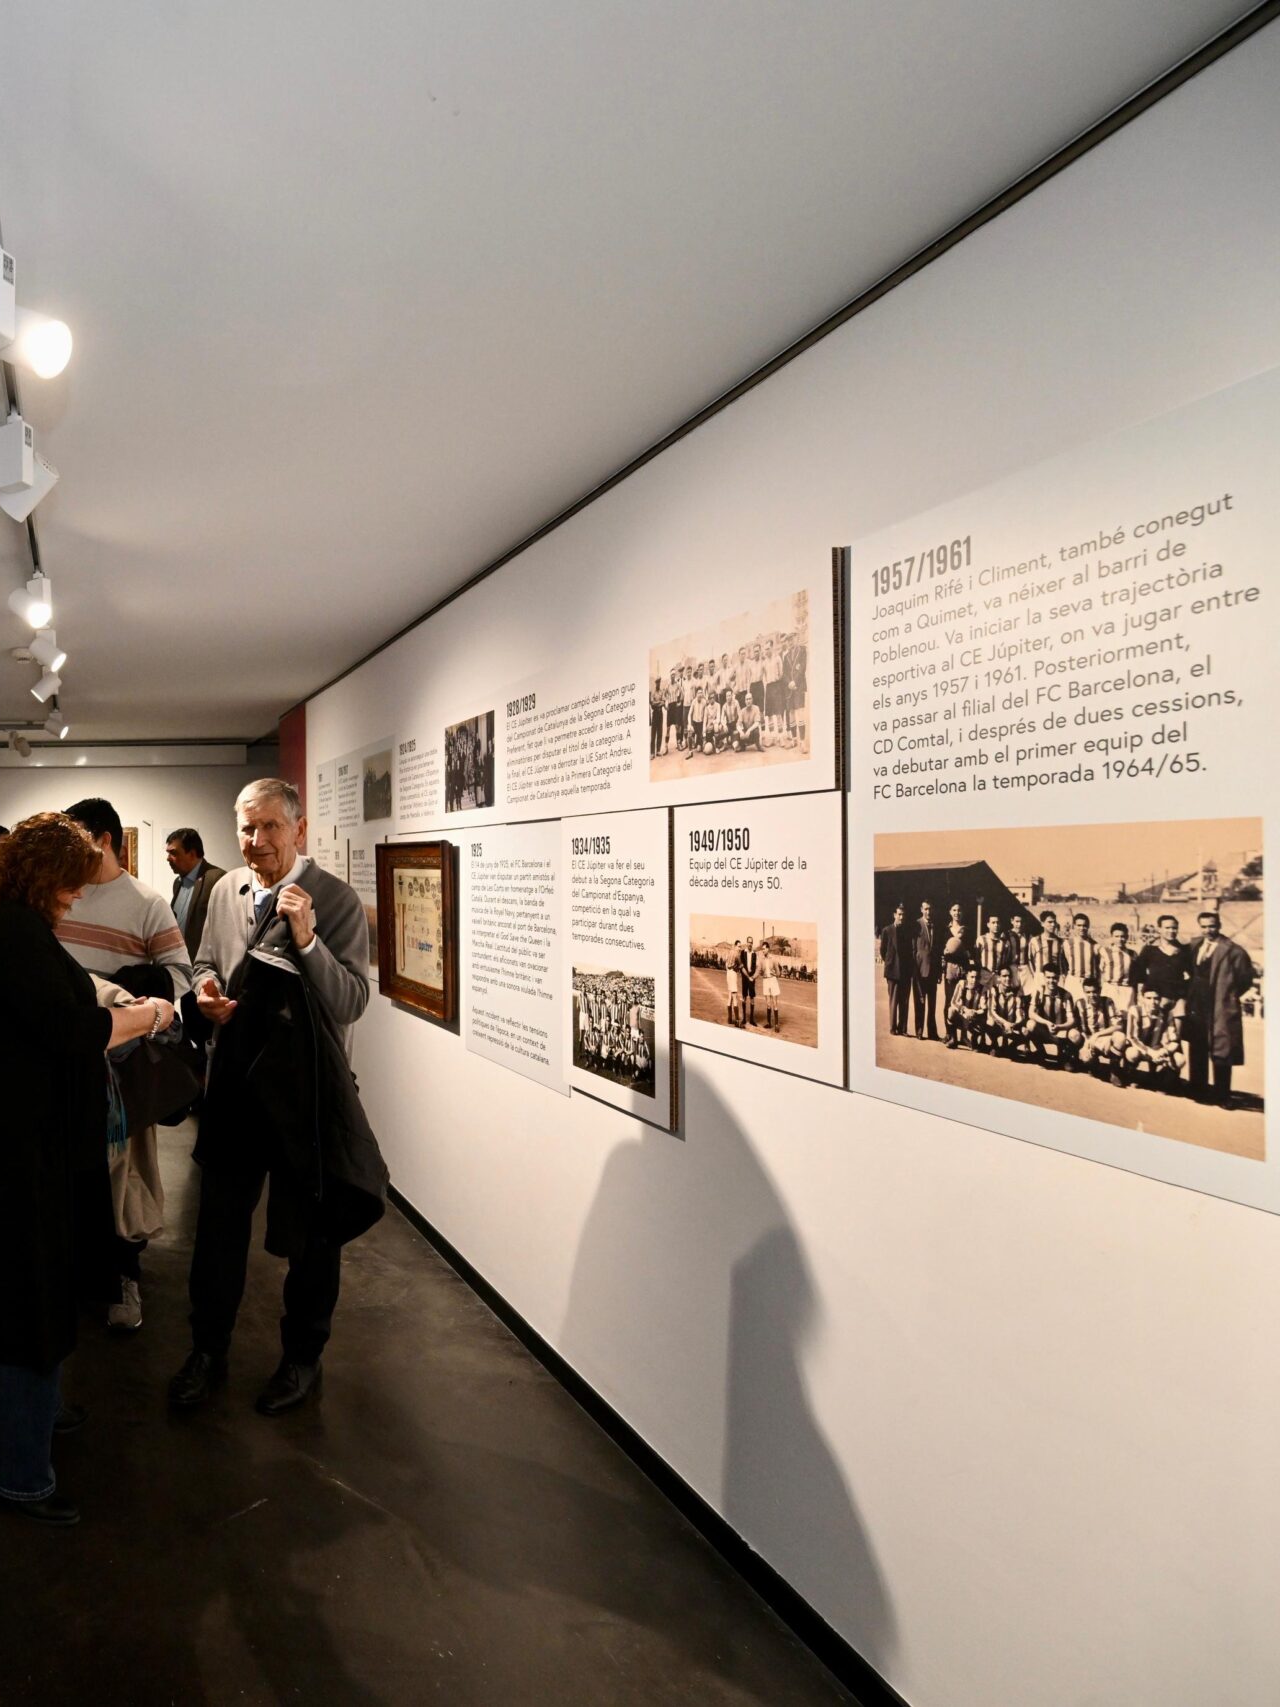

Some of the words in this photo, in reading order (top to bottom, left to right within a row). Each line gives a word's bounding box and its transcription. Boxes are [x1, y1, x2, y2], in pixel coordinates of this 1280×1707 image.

[872, 593, 929, 621] Joaquim
[934, 578, 964, 601] Rifé
[978, 553, 1052, 586] Climent,
[1059, 525, 1125, 562] també
[1133, 493, 1233, 538] conegut
[872, 536, 972, 598] 1957/1961
[872, 626, 900, 643] com
[904, 623, 912, 634] a
[917, 602, 978, 630] Quimet,
[983, 596, 1002, 610] va
[1009, 577, 1066, 604] néixer
[1072, 564, 1089, 586] al
[1098, 548, 1147, 579] barri
[1156, 539, 1187, 562] de
[873, 639, 940, 665] Poblenou.
[944, 629, 964, 646] Va
[969, 616, 1021, 641] iniciar
[1027, 608, 1042, 626] la
[1049, 598, 1093, 620] seva
[1100, 562, 1223, 606] trajectòria
[872, 664, 936, 689] esportiva
[941, 653, 954, 672] al
[960, 647, 983, 667] CE
[987, 636, 1053, 662] Júpiter,
[1060, 629, 1084, 645] on
[1091, 621, 1115, 636] va
[1122, 605, 1182, 637] jugar
[1191, 587, 1260, 615] entre
[872, 693, 892, 710] els
[896, 689, 928, 707] anys
[933, 676, 969, 698] 1957
[984, 665, 1027, 687] 1961.
[1034, 633, 1190, 678] Posteriorment,
[506, 693, 536, 718] 1928/1929
[873, 721, 888, 732] va
[892, 711, 939, 734] passar
[943, 702, 956, 721] al
[962, 695, 995, 717] filial
[1002, 689, 1029, 710] del
[1036, 684, 1062, 705] FC
[1068, 669, 1181, 699] Barcelona,
[1190, 654, 1211, 678] el
[873, 738, 894, 755] CD
[897, 728, 953, 752] Comtal,
[968, 717, 1036, 742] després
[1043, 711, 1067, 731] de
[1074, 706, 1124, 726] dues
[1132, 690, 1243, 718] cessions,
[873, 766, 888, 777] va
[892, 757, 949, 776] debutar
[954, 748, 989, 768] amb
[994, 745, 1009, 764] el
[1016, 742, 1077, 766] primer
[1084, 731, 1143, 756] equip
[1151, 721, 1187, 745] del
[874, 784, 891, 800] FC
[896, 778, 967, 798] Barcelona
[973, 774, 986, 791] la
[992, 763, 1094, 792] temporada
[1102, 752, 1207, 779] 1964/65.
[471, 842, 483, 857] 1925
[571, 836, 611, 855] 1934/1935
[689, 827, 750, 852] 1949/1950
[571, 860, 577, 870] El
[577, 859, 586, 870] CE
[587, 861, 606, 872] Júpiter
[607, 862, 615, 870] va
[615, 859, 625, 870] fer
[626, 860, 632, 870] el
[633, 862, 645, 870] seu
[689, 858, 712, 872] Equip
[713, 857, 727, 870] del
[729, 857, 742, 870] CE
[745, 858, 778, 873] Júpiter
[781, 856, 795, 870] de
[798, 856, 807, 870] la
[572, 875, 588, 884] debut
[593, 875, 599, 885] la
[600, 874, 622, 888] Segona
[623, 875, 655, 889] Categoria
[689, 876, 719, 888] dècada
[721, 876, 740, 889] dels
[742, 880, 764, 893] anys
[767, 876, 783, 890] 50.
[572, 888, 580, 898] del
[581, 888, 611, 901] Campionat
[613, 890, 645, 905] d'Espanya,
[572, 905, 601, 915] competició
[602, 907, 610, 915] en
[611, 906, 617, 916] la
[618, 907, 632, 918] qual
[633, 910, 641, 918] va
[572, 919, 598, 930] participar
[598, 919, 618, 931] durant
[619, 921, 634, 933] dues
[572, 932, 604, 944] temporades
[605, 937, 646, 951] consecutives.
